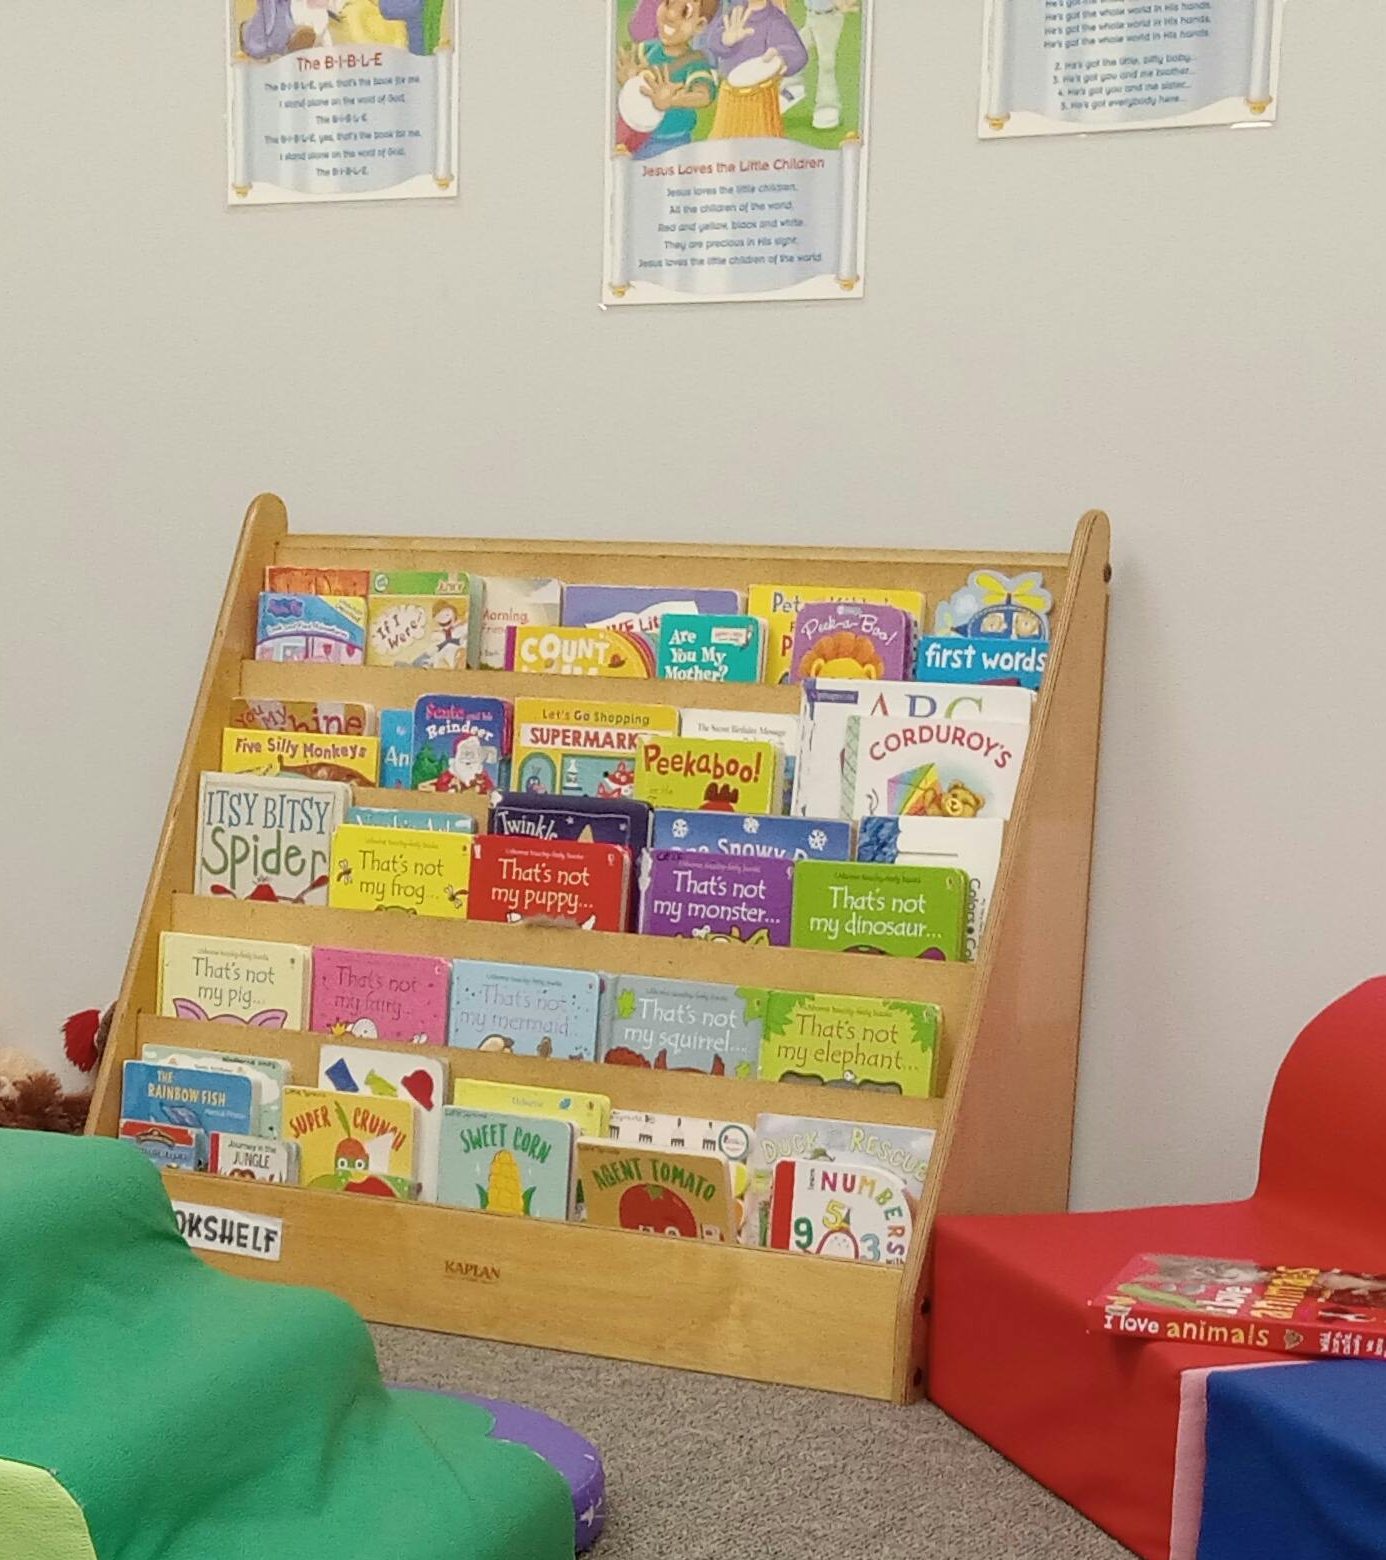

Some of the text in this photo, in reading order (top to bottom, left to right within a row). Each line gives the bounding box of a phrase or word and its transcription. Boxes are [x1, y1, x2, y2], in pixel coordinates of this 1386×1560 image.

[297, 57, 320, 71] The
[643, 158, 824, 177] Jesus Loves the Little Children
[377, 614, 400, 640] If I
[669, 629, 697, 645] Are
[801, 613, 898, 647] Peek-a-Boo!
[521, 633, 610, 664] COUNT
[671, 647, 726, 666] You My
[925, 643, 1048, 672] first words
[665, 665, 728, 682] Mother?
[542, 709, 650, 726] Let's Go Shopping
[426, 722, 493, 742] Reindeer
[235, 736, 367, 760] Five Silly Monkeys
[869, 725, 1012, 768] CORDUROY'S
[644, 744, 763, 783] Peekaboo!
[206, 790, 258, 827] ITSY
[263, 794, 331, 834] BITSY
[202, 826, 327, 889] Spider
[359, 850, 444, 878] That's not
[498, 858, 590, 886] That's not
[673, 870, 766, 900] That's not
[360, 875, 440, 904] my frog...
[491, 887, 593, 914] my puppy...
[829, 885, 926, 914] That's not
[653, 900, 780, 925] my monster...
[809, 916, 942, 940] my dinosaur...
[192, 956, 275, 985] That's not
[198, 983, 265, 1010] my pig...
[334, 995, 360, 1016] my
[483, 983, 531, 1009] That's
[460, 1010, 486, 1034] my
[639, 998, 737, 1028] That's not
[624, 1026, 747, 1055] my squirrel...
[796, 1013, 898, 1044] That's not
[777, 1041, 919, 1071] my elephant...
[157, 1071, 174, 1083] THE
[148, 1082, 226, 1106] RAINBOW FISH
[289, 1105, 331, 1139] SUPER
[228, 1140, 256, 1152] Journey
[460, 1122, 552, 1164] SWEET CORN
[763, 1130, 819, 1164] DUCK
[233, 1152, 270, 1169] JUNGLE
[592, 1158, 716, 1202] AGENT TOMATO
[821, 1170, 905, 1256] NUMBERS
[822, 1199, 845, 1230] 5
[794, 1216, 813, 1249] 9
[860, 1233, 881, 1261] 3
[445, 1260, 501, 1280] KAPLAN
[1104, 1314, 1270, 1347] I love animals
